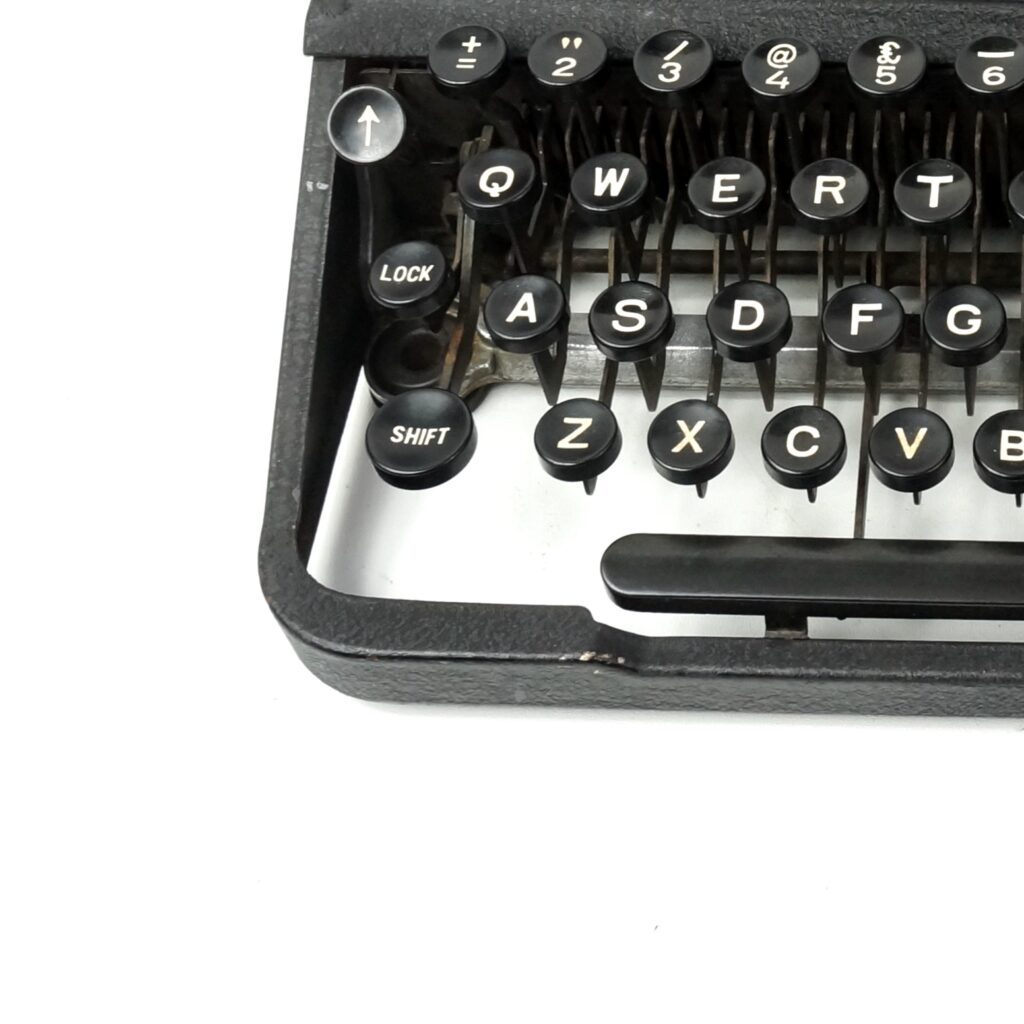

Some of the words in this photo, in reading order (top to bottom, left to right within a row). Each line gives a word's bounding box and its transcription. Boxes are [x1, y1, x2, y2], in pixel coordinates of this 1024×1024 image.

[551, 56, 578, 77] 2
[766, 43, 798, 70] @
[876, 41, 902, 65] £
[657, 61, 683, 83] 3
[764, 69, 791, 90] 4
[874, 64, 898, 86] 5
[981, 65, 1006, 86] 6
[479, 165, 515, 198] Q
[593, 166, 630, 197] W
[711, 173, 741, 203] E
[813, 175, 847, 205] R
[916, 174, 954, 209] T
[379, 263, 435, 283] LOCK
[505, 291, 537, 324] A
[611, 298, 648, 333] S
[730, 299, 765, 331] D
[850, 302, 883, 336] F
[946, 303, 982, 336] G
[389, 425, 451, 446] SHIFT
[556, 416, 594, 449] Z
[670, 419, 707, 454] X
[785, 424, 821, 458] C
[894, 426, 928, 460] V
